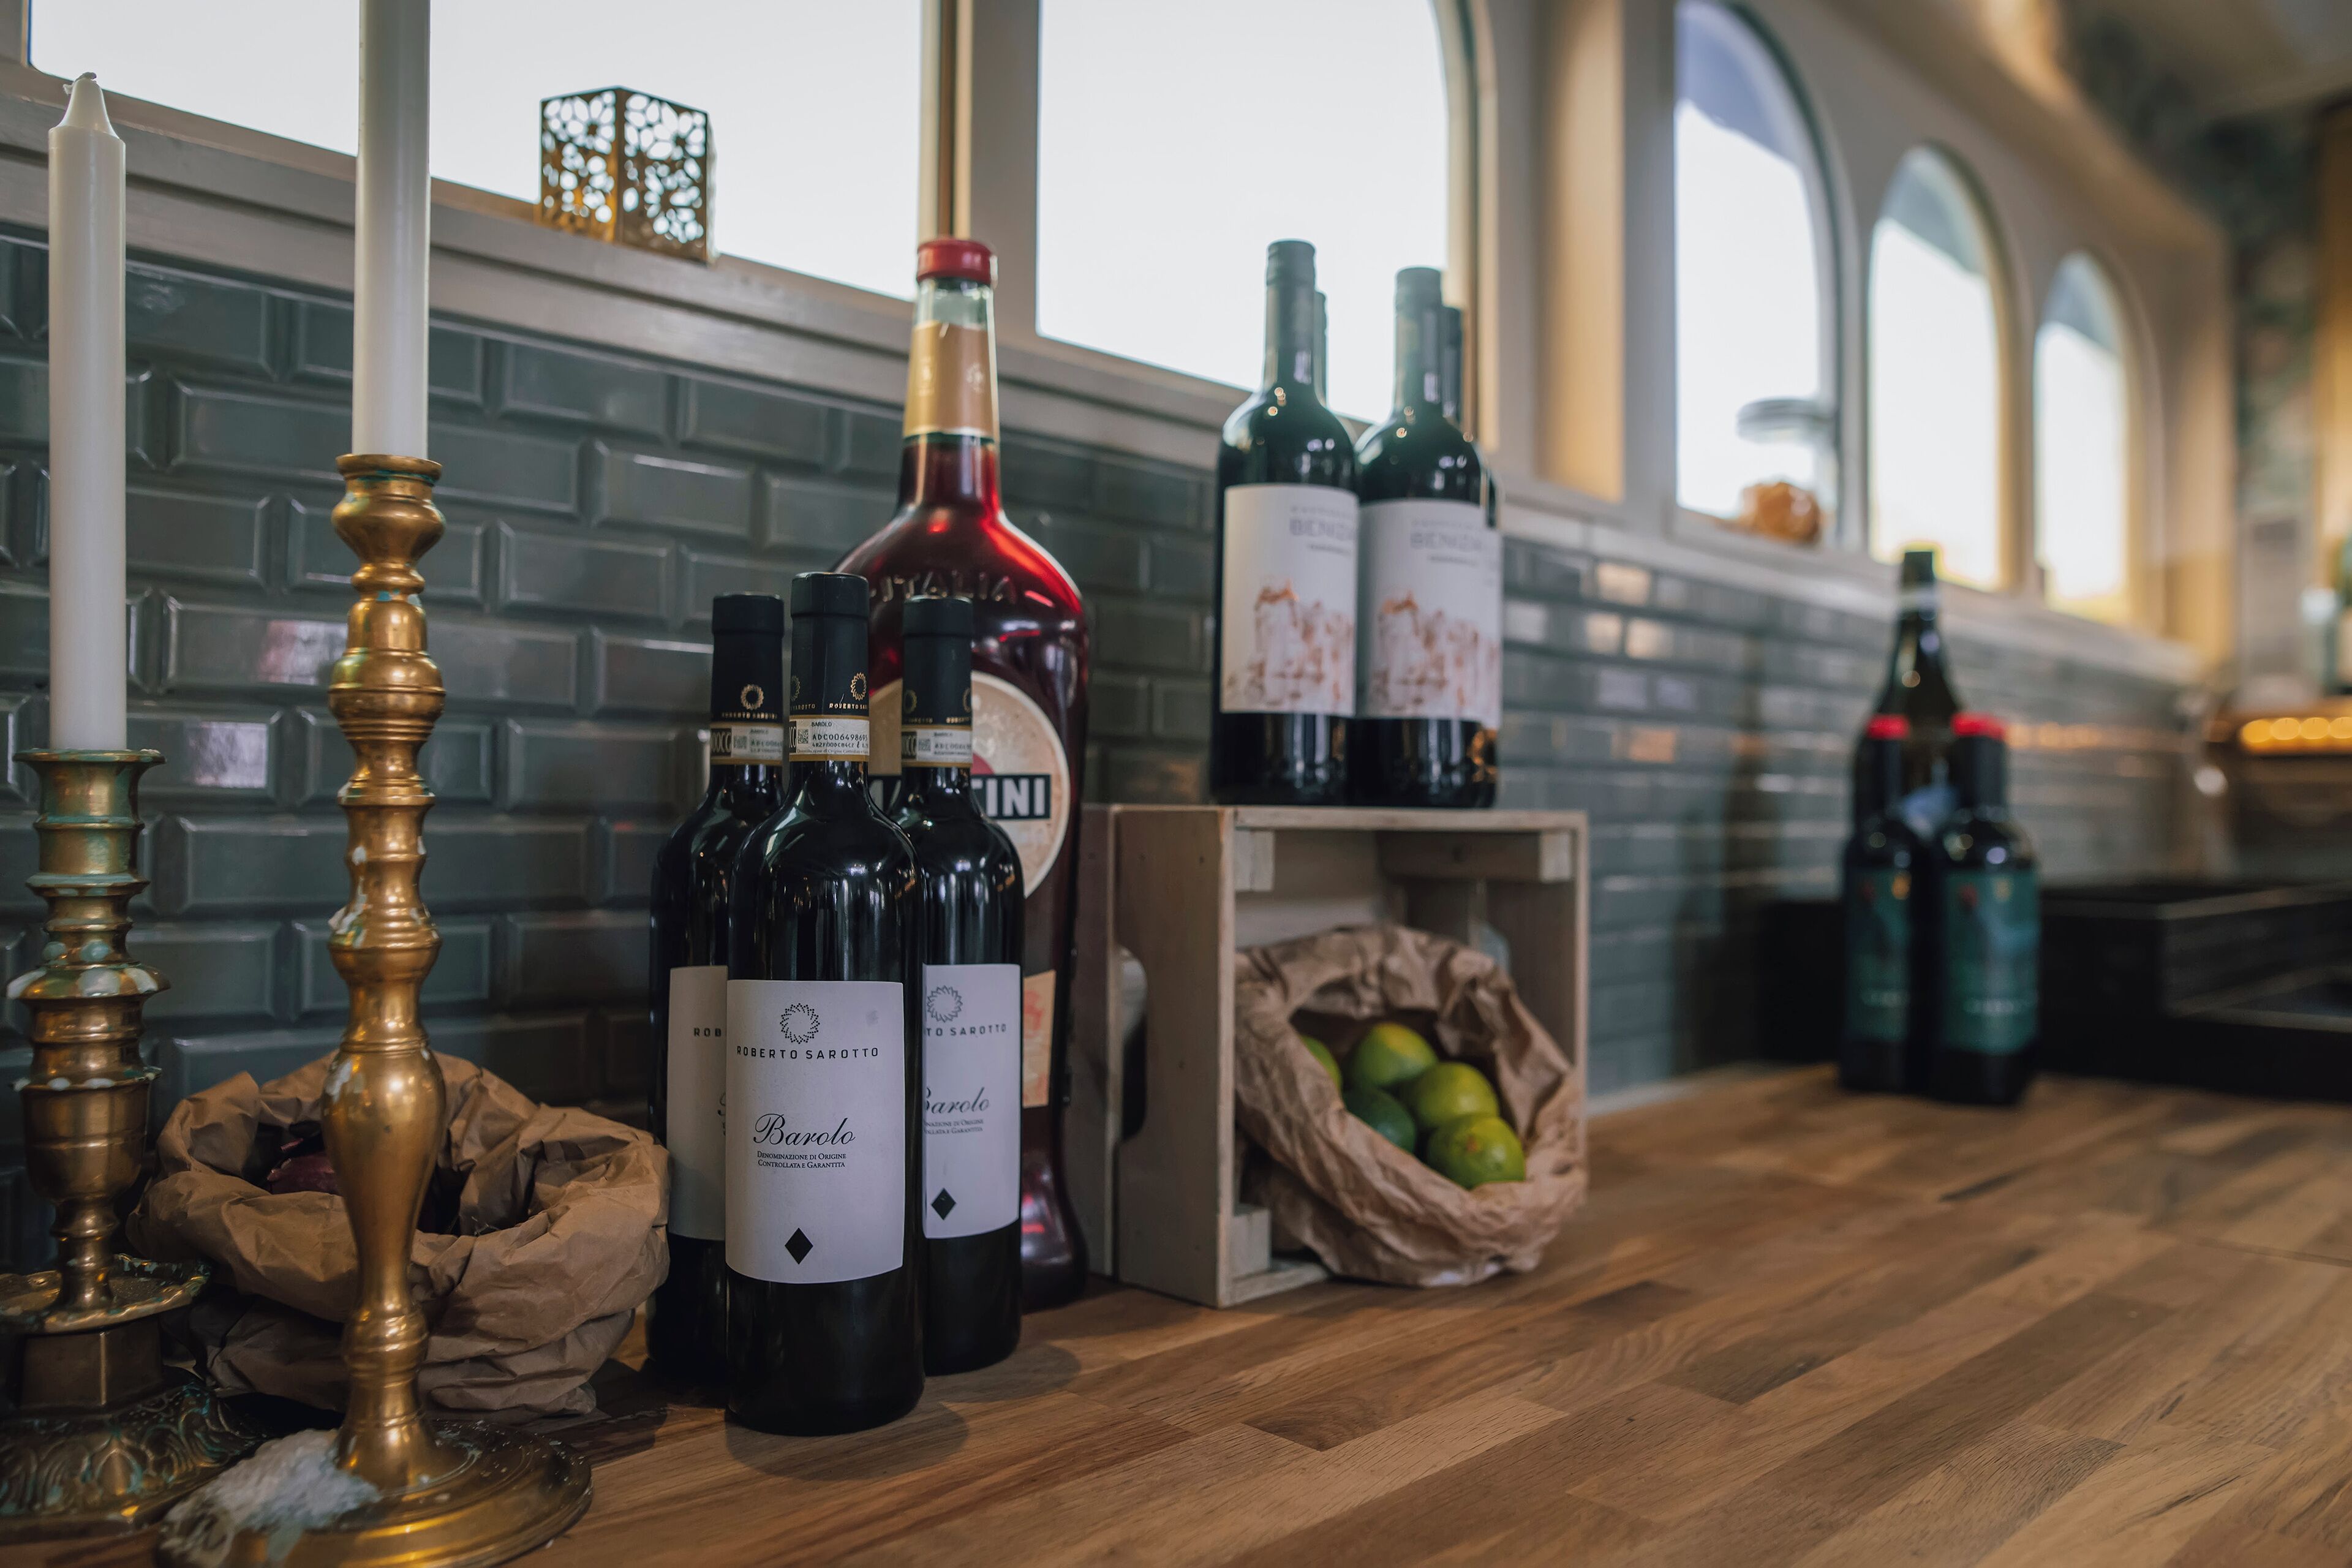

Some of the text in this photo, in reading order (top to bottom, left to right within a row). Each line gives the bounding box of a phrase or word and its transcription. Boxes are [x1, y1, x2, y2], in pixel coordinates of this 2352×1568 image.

[693, 1027, 722, 1038] ROB
[950, 1023, 1007, 1036] SAROTTO
[736, 1045, 879, 1060] ROBERTO SAROTTO
[753, 1113, 856, 1146] Barolo
[756, 1151, 809, 1160] DENOMINAZIONE
[758, 1159, 801, 1169] CONTROLLATA
